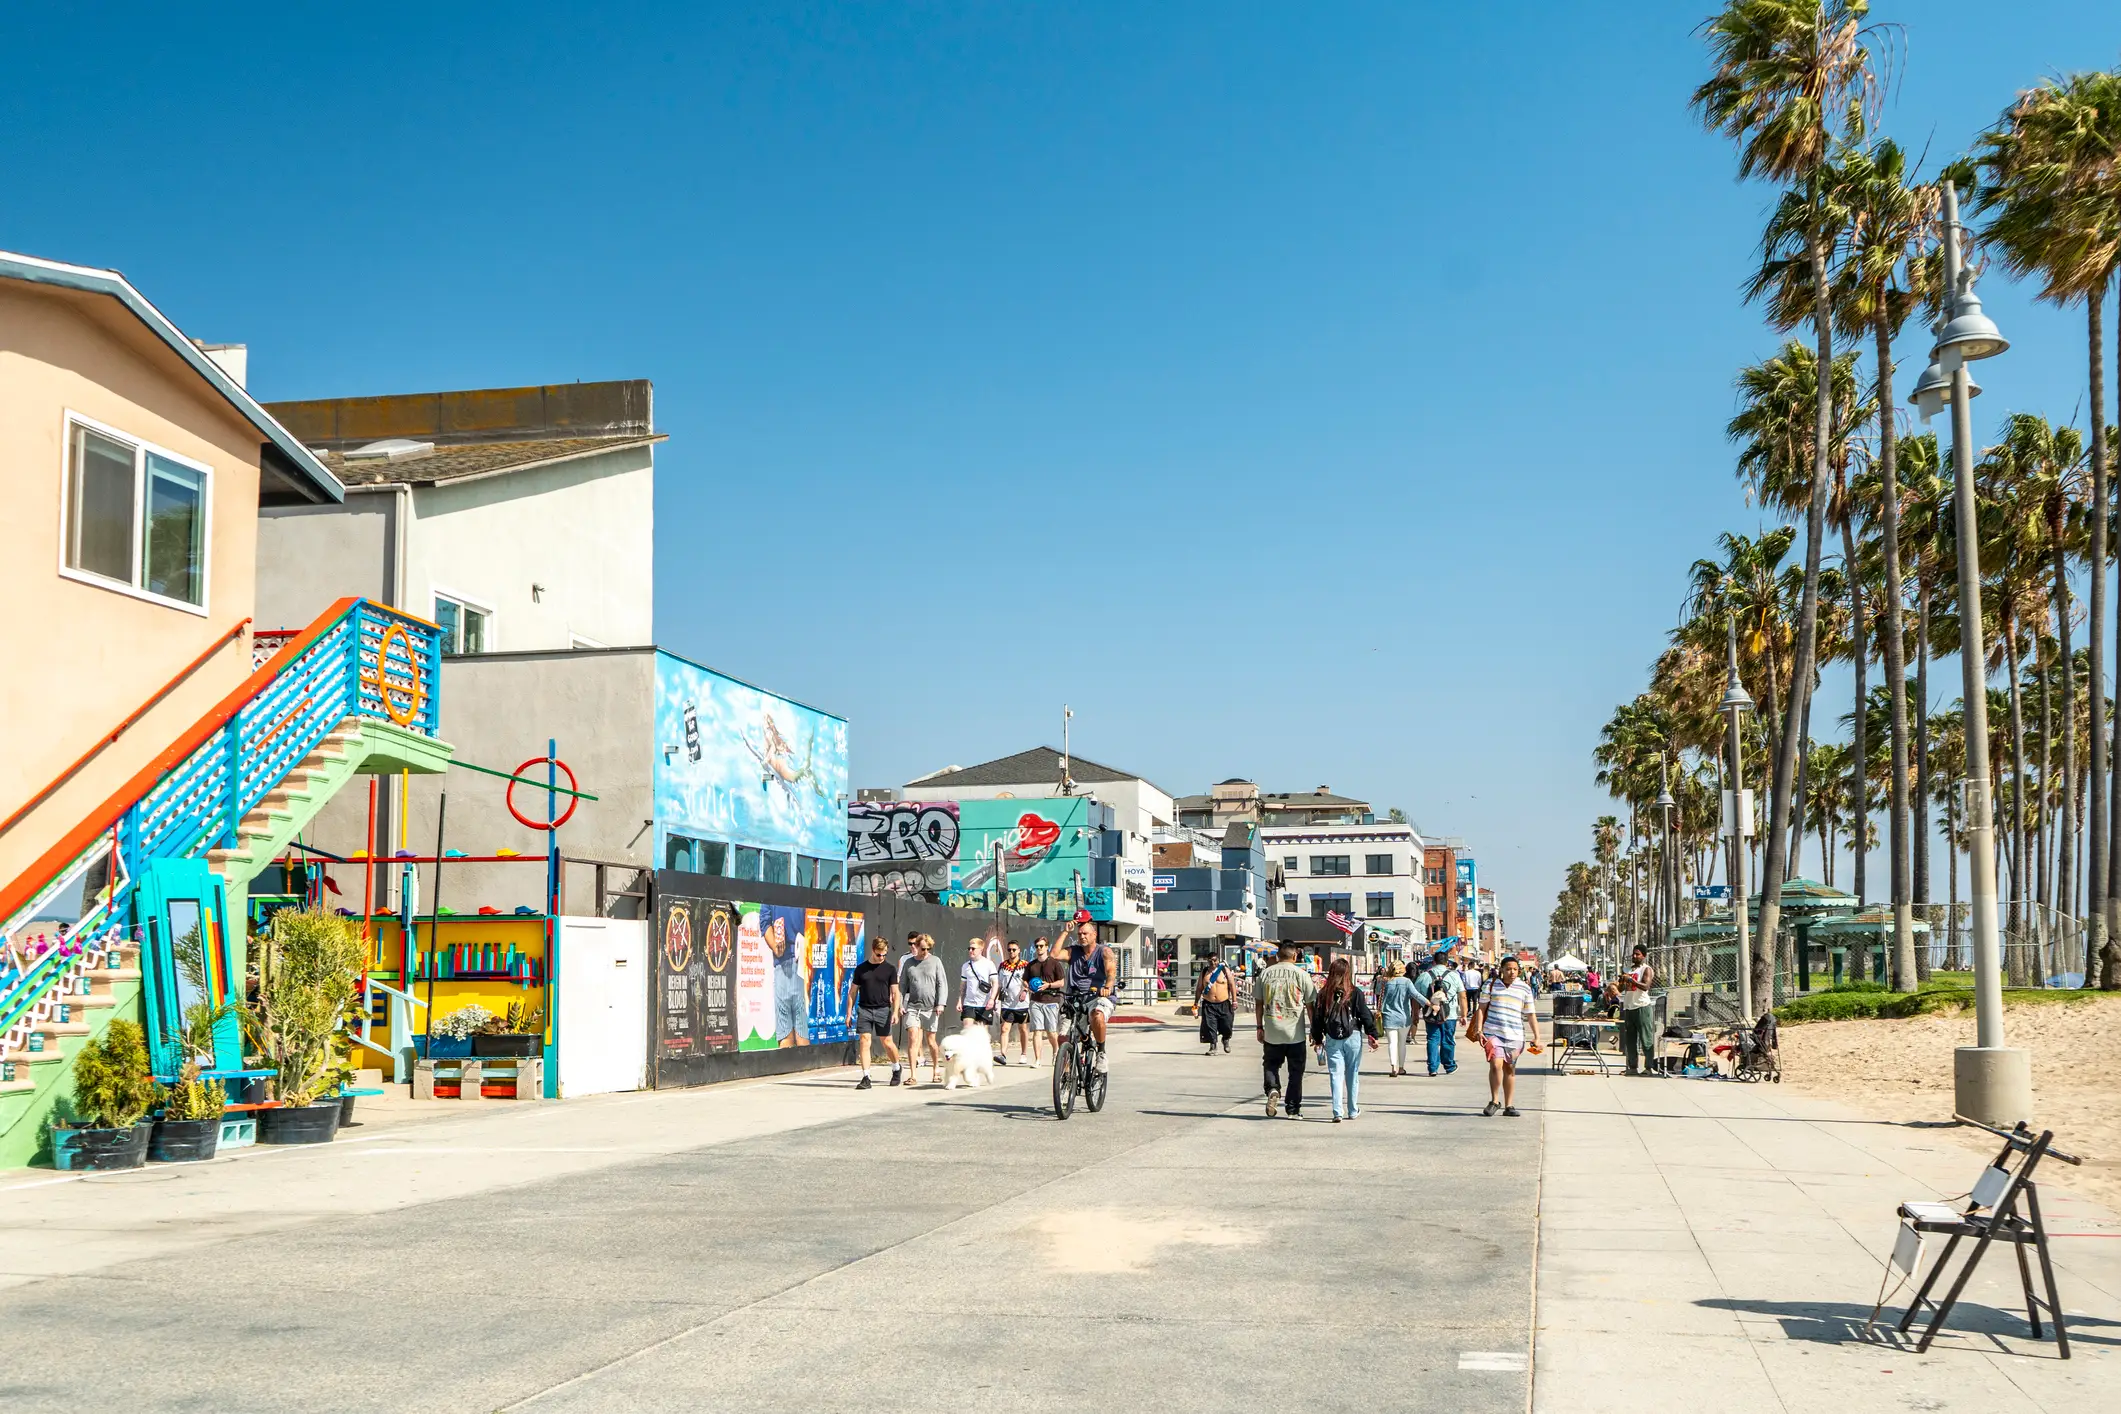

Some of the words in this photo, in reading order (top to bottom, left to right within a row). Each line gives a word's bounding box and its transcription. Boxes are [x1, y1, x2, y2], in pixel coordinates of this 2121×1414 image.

[1696, 887, 1711, 896] Park
[741, 940, 753, 952] thing
[753, 941, 759, 950] to
[812, 951, 827, 961] HARD
[843, 952, 857, 962] HARD
[741, 966, 754, 975] butts
[754, 967, 765, 976] since
[668, 975, 682, 990] REIGN
[682, 975, 688, 990] IN
[708, 975, 721, 990] REIGN
[721, 975, 727, 990] IN
[668, 990, 688, 1010] BLOOD
[708, 989, 727, 1008] BLOOD
